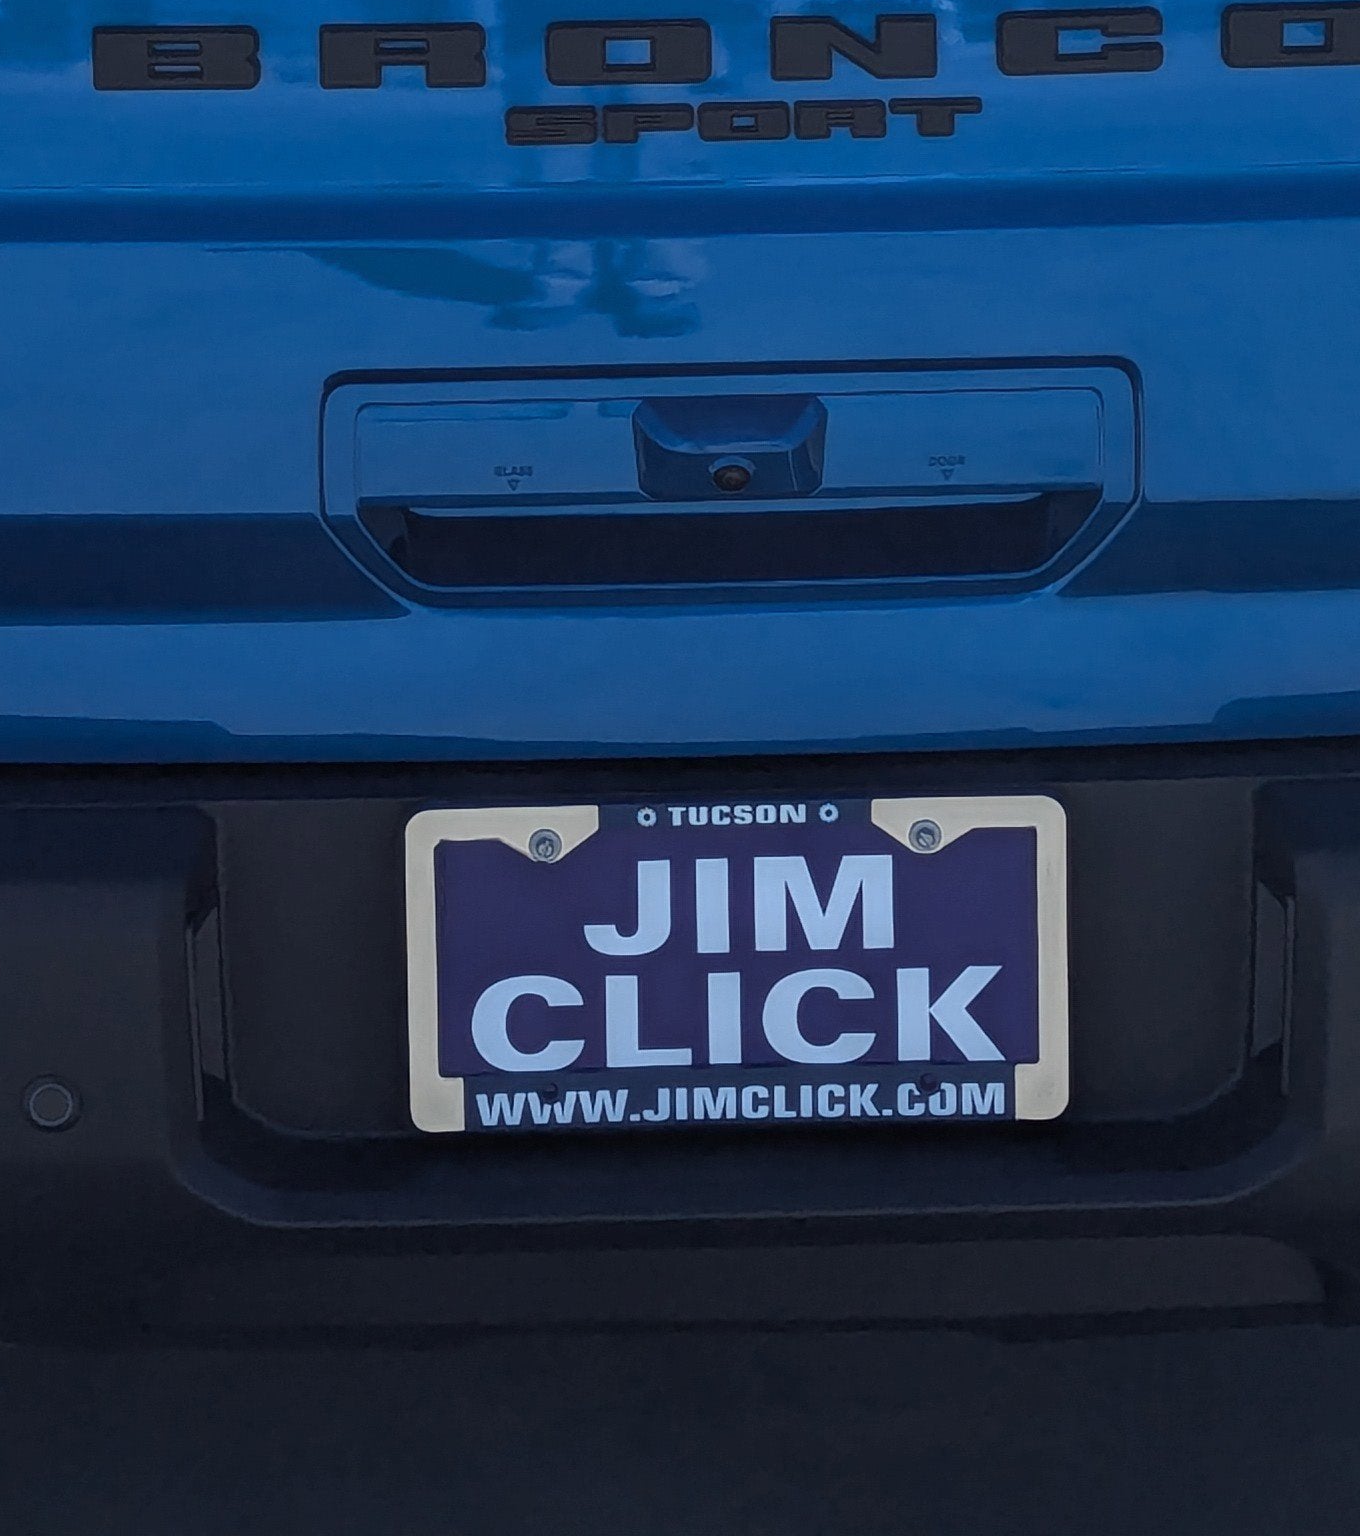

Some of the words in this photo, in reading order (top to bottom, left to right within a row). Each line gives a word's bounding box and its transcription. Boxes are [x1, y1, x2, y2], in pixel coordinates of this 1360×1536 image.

[504, 96, 982, 145] SPORT
[668, 804, 806, 826] TUCSON
[583, 854, 895, 956] JIM
[471, 965, 1006, 1072] CLICK
[476, 1082, 1006, 1126] WWW.JIMCLICK.COM
